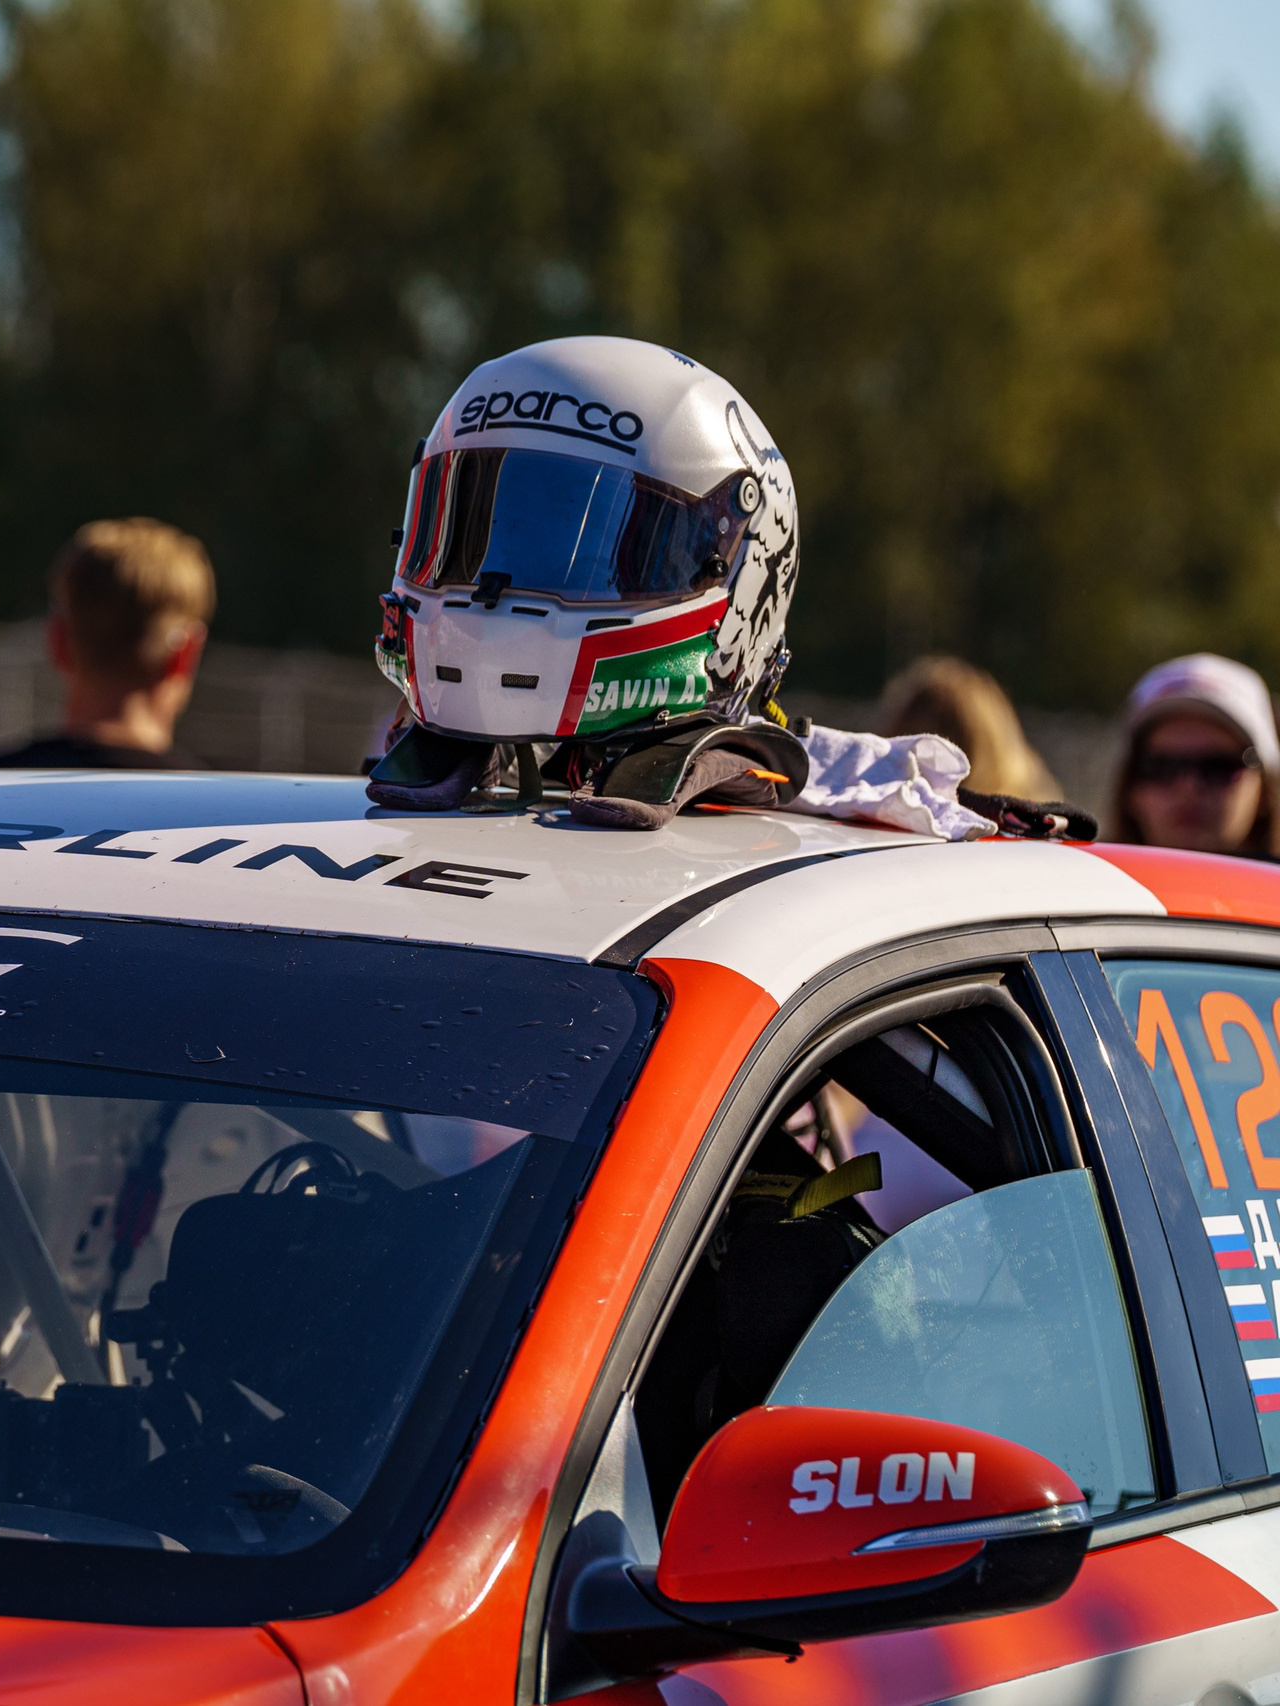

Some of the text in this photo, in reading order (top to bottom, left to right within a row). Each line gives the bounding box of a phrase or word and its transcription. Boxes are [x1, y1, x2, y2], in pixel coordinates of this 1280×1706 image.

[460, 389, 644, 444] sparco
[584, 673, 705, 713] SAVIN A.
[1137, 988, 1280, 1190] 12
[789, 1451, 976, 1515] SLON
